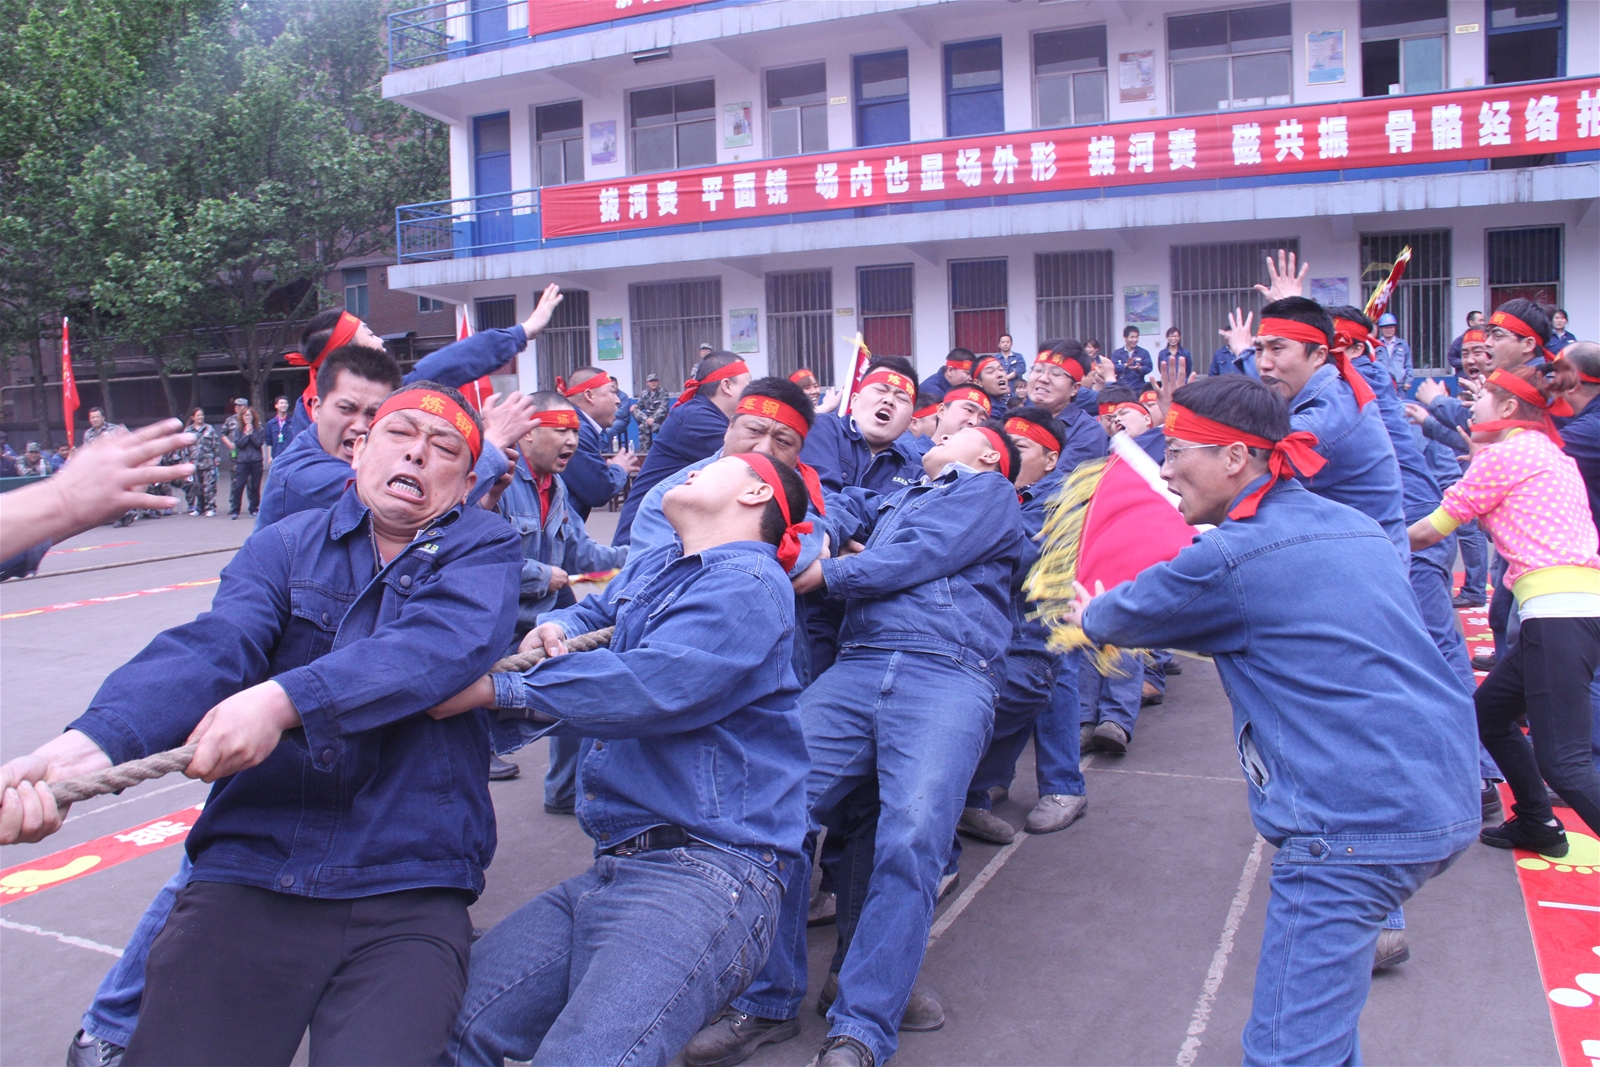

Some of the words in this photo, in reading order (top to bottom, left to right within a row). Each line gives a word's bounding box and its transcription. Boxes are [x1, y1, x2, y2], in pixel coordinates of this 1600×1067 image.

[599, 180, 678, 223] 拔河赛
[701, 168, 789, 212] 平面镜
[814, 141, 1057, 200] 场内也显场外形
[1087, 127, 1197, 177] 拔河赛
[1231, 116, 1349, 166] 磁共振
[419, 394, 473, 439] 炼钢
